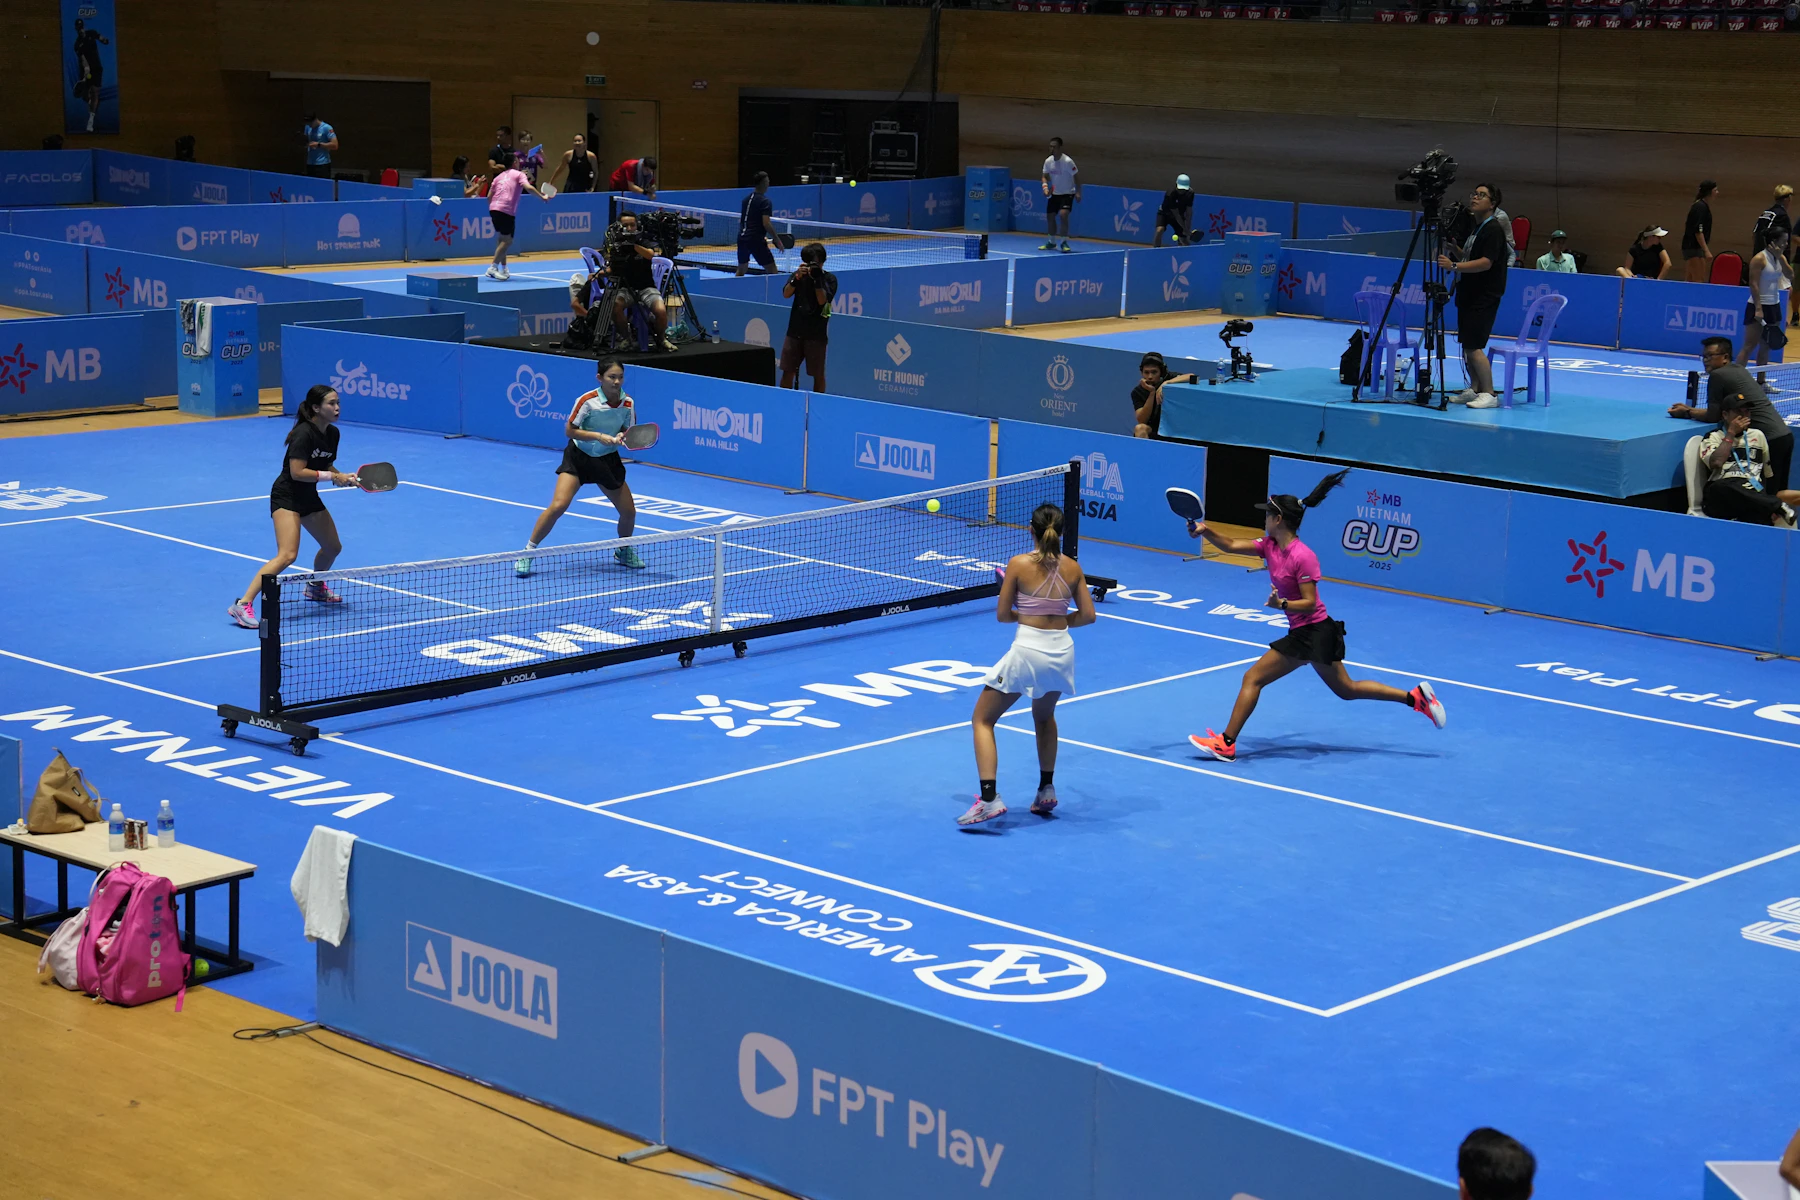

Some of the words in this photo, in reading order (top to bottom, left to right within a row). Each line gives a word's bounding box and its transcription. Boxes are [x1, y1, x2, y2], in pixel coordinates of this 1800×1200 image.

[1405, 15, 1418, 23] VIP
[1666, 20, 1681, 29] VIP
[1697, 21, 1713, 29] VIP
[1728, 22, 1744, 30] VIP
[5, 172, 82, 183] FACOLOS
[558, 215, 589, 230] JOOLA
[772, 208, 812, 219] COLOS
[66, 221, 105, 246] PPA
[462, 217, 495, 240] MB
[1235, 216, 1267, 232] MB
[200, 230, 227, 245] FPT
[231, 230, 259, 248] Play
[1229, 264, 1253, 274] CUP
[1260, 264, 1276, 274] CUP
[134, 277, 168, 308] MB
[1055, 280, 1077, 296] FPT
[1080, 279, 1103, 297] Play
[1305, 271, 1326, 296] M
[831, 293, 862, 316] MB
[1690, 311, 1734, 331] JOOLA
[182, 342, 198, 356] CU
[222, 344, 252, 359] CUP
[45, 348, 102, 383] MB
[330, 371, 411, 401] zocker
[874, 368, 891, 382] VIET
[895, 372, 924, 386] HUONG
[879, 383, 919, 396] CERAMICS
[1040, 398, 1077, 412] ORIENT
[673, 399, 763, 444] SUNWORLD
[695, 436, 706, 446] BA
[706, 438, 717, 448] NA
[718, 440, 738, 452] HILLS
[883, 444, 932, 474] JOOLA
[1080, 489, 1104, 498] KLEBALL
[1106, 492, 1124, 501] TOUR
[1382, 494, 1401, 507] MB
[1079, 499, 1117, 522] ASIA
[1357, 505, 1412, 526] VIETNAM
[1342, 519, 1420, 557] CUP
[1369, 560, 1392, 571] 2025
[1632, 548, 1716, 602] MB
[887, 605, 910, 615] JOOLA
[420, 623, 639, 666] MB
[509, 672, 537, 683] JOOLA
[800, 660, 996, 707] MB
[1515, 662, 1639, 687] Play
[1632, 685, 1758, 709] FPT
[255, 718, 282, 731] JOOLA
[0, 705, 394, 819] VIETNAM
[604, 865, 708, 895] ASIA
[699, 870, 913, 932] CONNECT
[734, 902, 938, 963] AMERICA
[458, 950, 552, 1025] JOOLA
[812, 1068, 894, 1138] FPT
[908, 1099, 1004, 1188] Play
